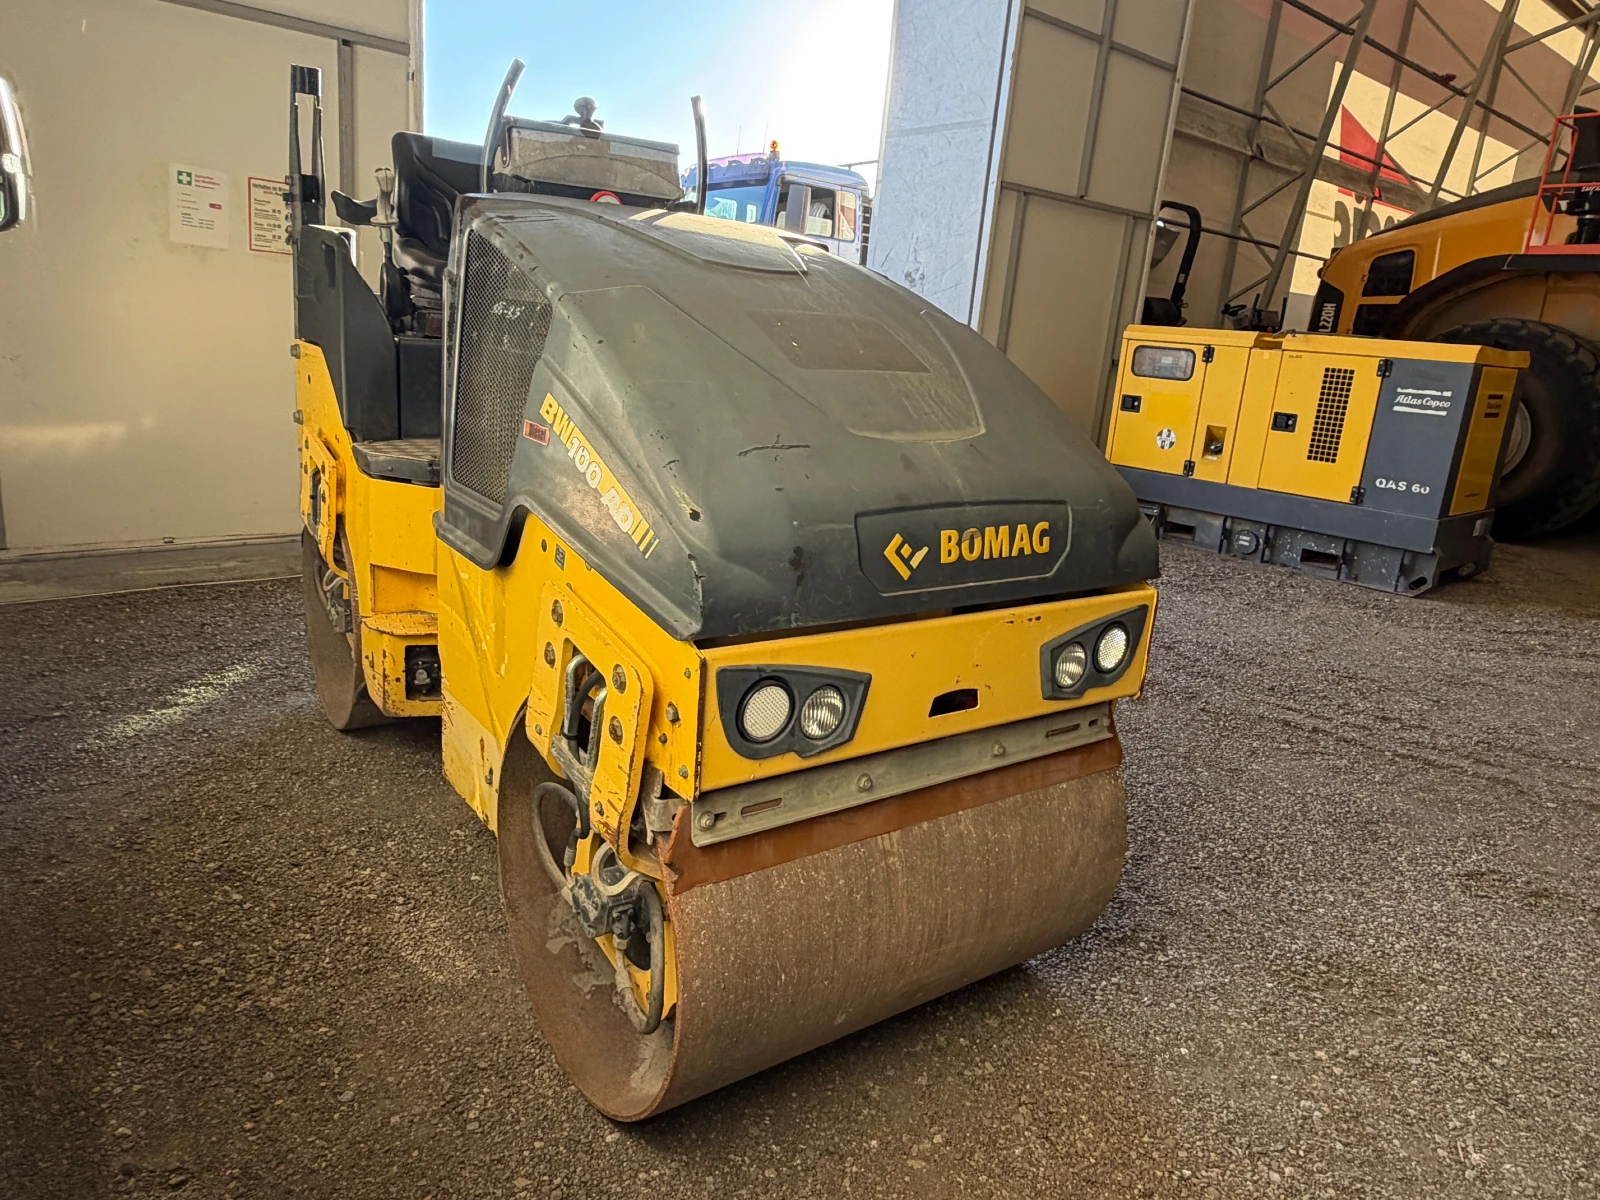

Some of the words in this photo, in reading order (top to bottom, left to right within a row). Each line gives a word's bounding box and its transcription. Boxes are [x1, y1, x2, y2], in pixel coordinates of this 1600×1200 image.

[1394, 394, 1422, 406] Atlas
[1422, 396, 1451, 408] Copco
[1375, 478, 1408, 492] QAS
[1411, 483, 1431, 495] 60
[940, 521, 1051, 564] BOMAG
